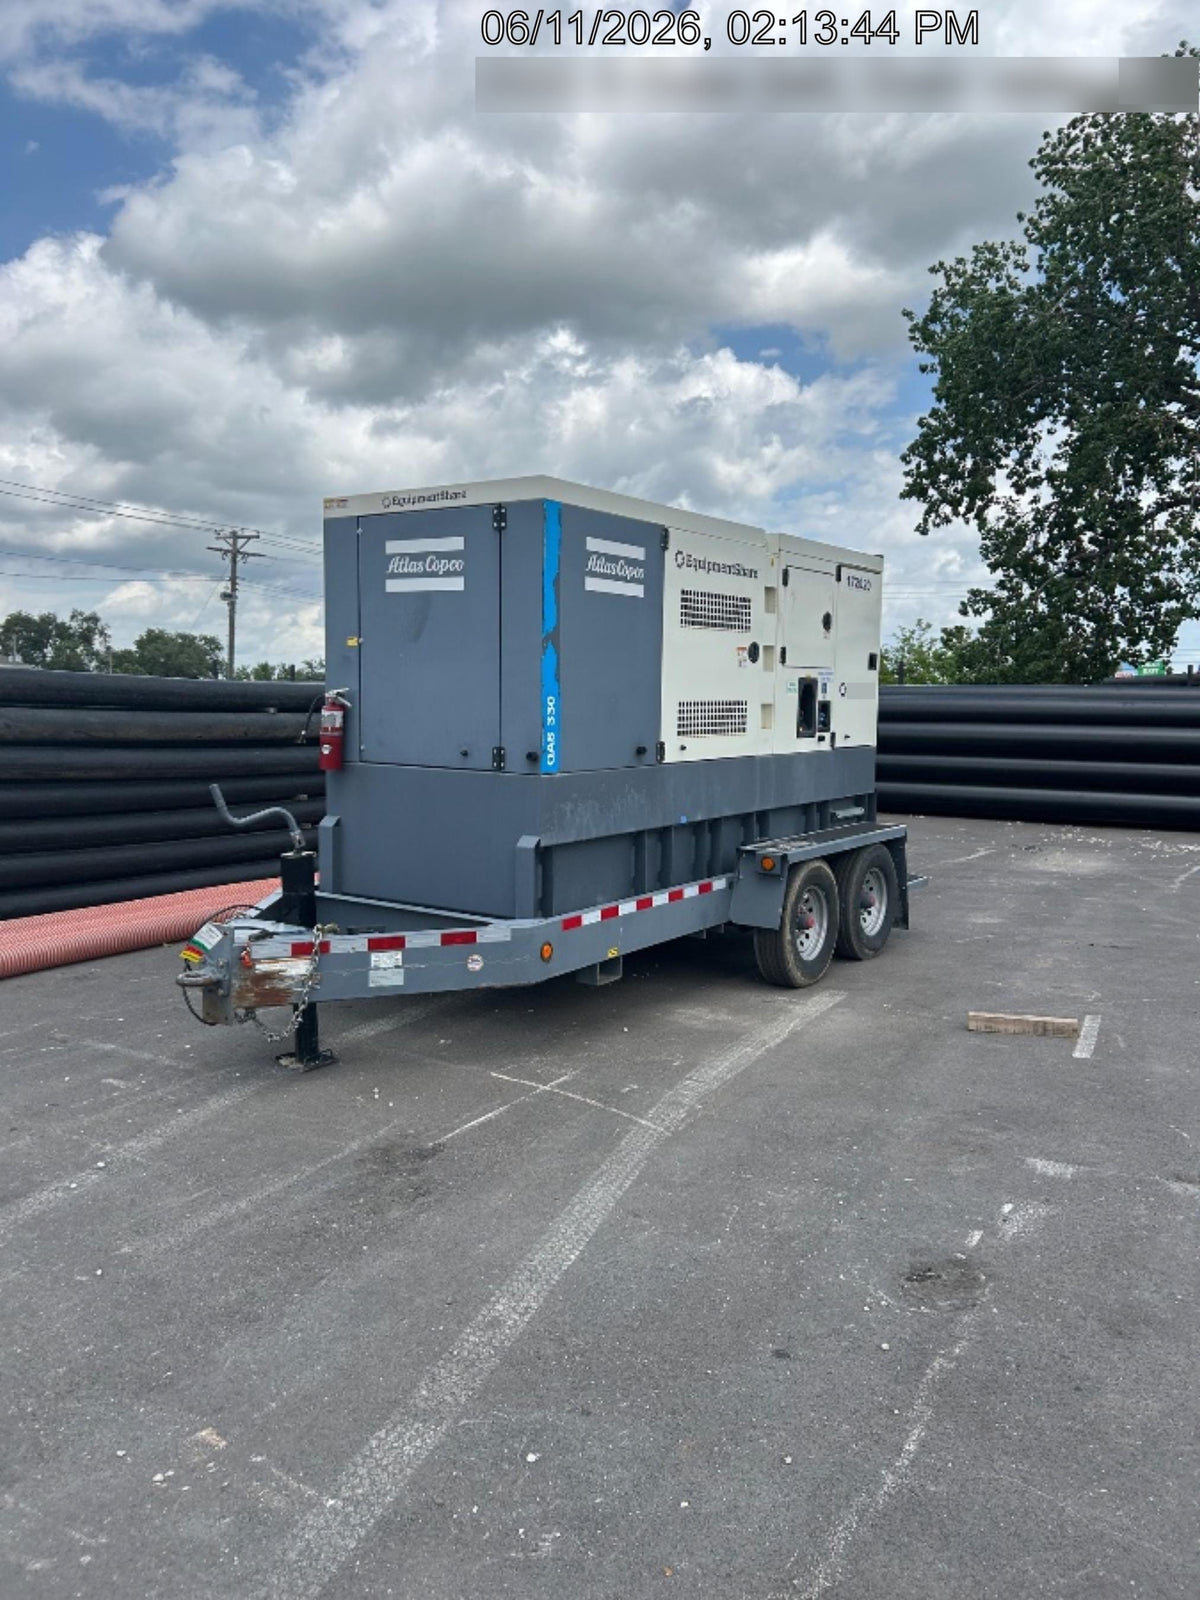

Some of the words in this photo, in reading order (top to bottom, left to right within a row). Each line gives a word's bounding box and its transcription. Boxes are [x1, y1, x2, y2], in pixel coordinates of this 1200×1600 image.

[386, 555, 424, 574] Atlas
[425, 555, 464, 575] Copco
[586, 554, 616, 575] Atlas
[616, 559, 645, 580] Copco
[546, 695, 556, 726] 330
